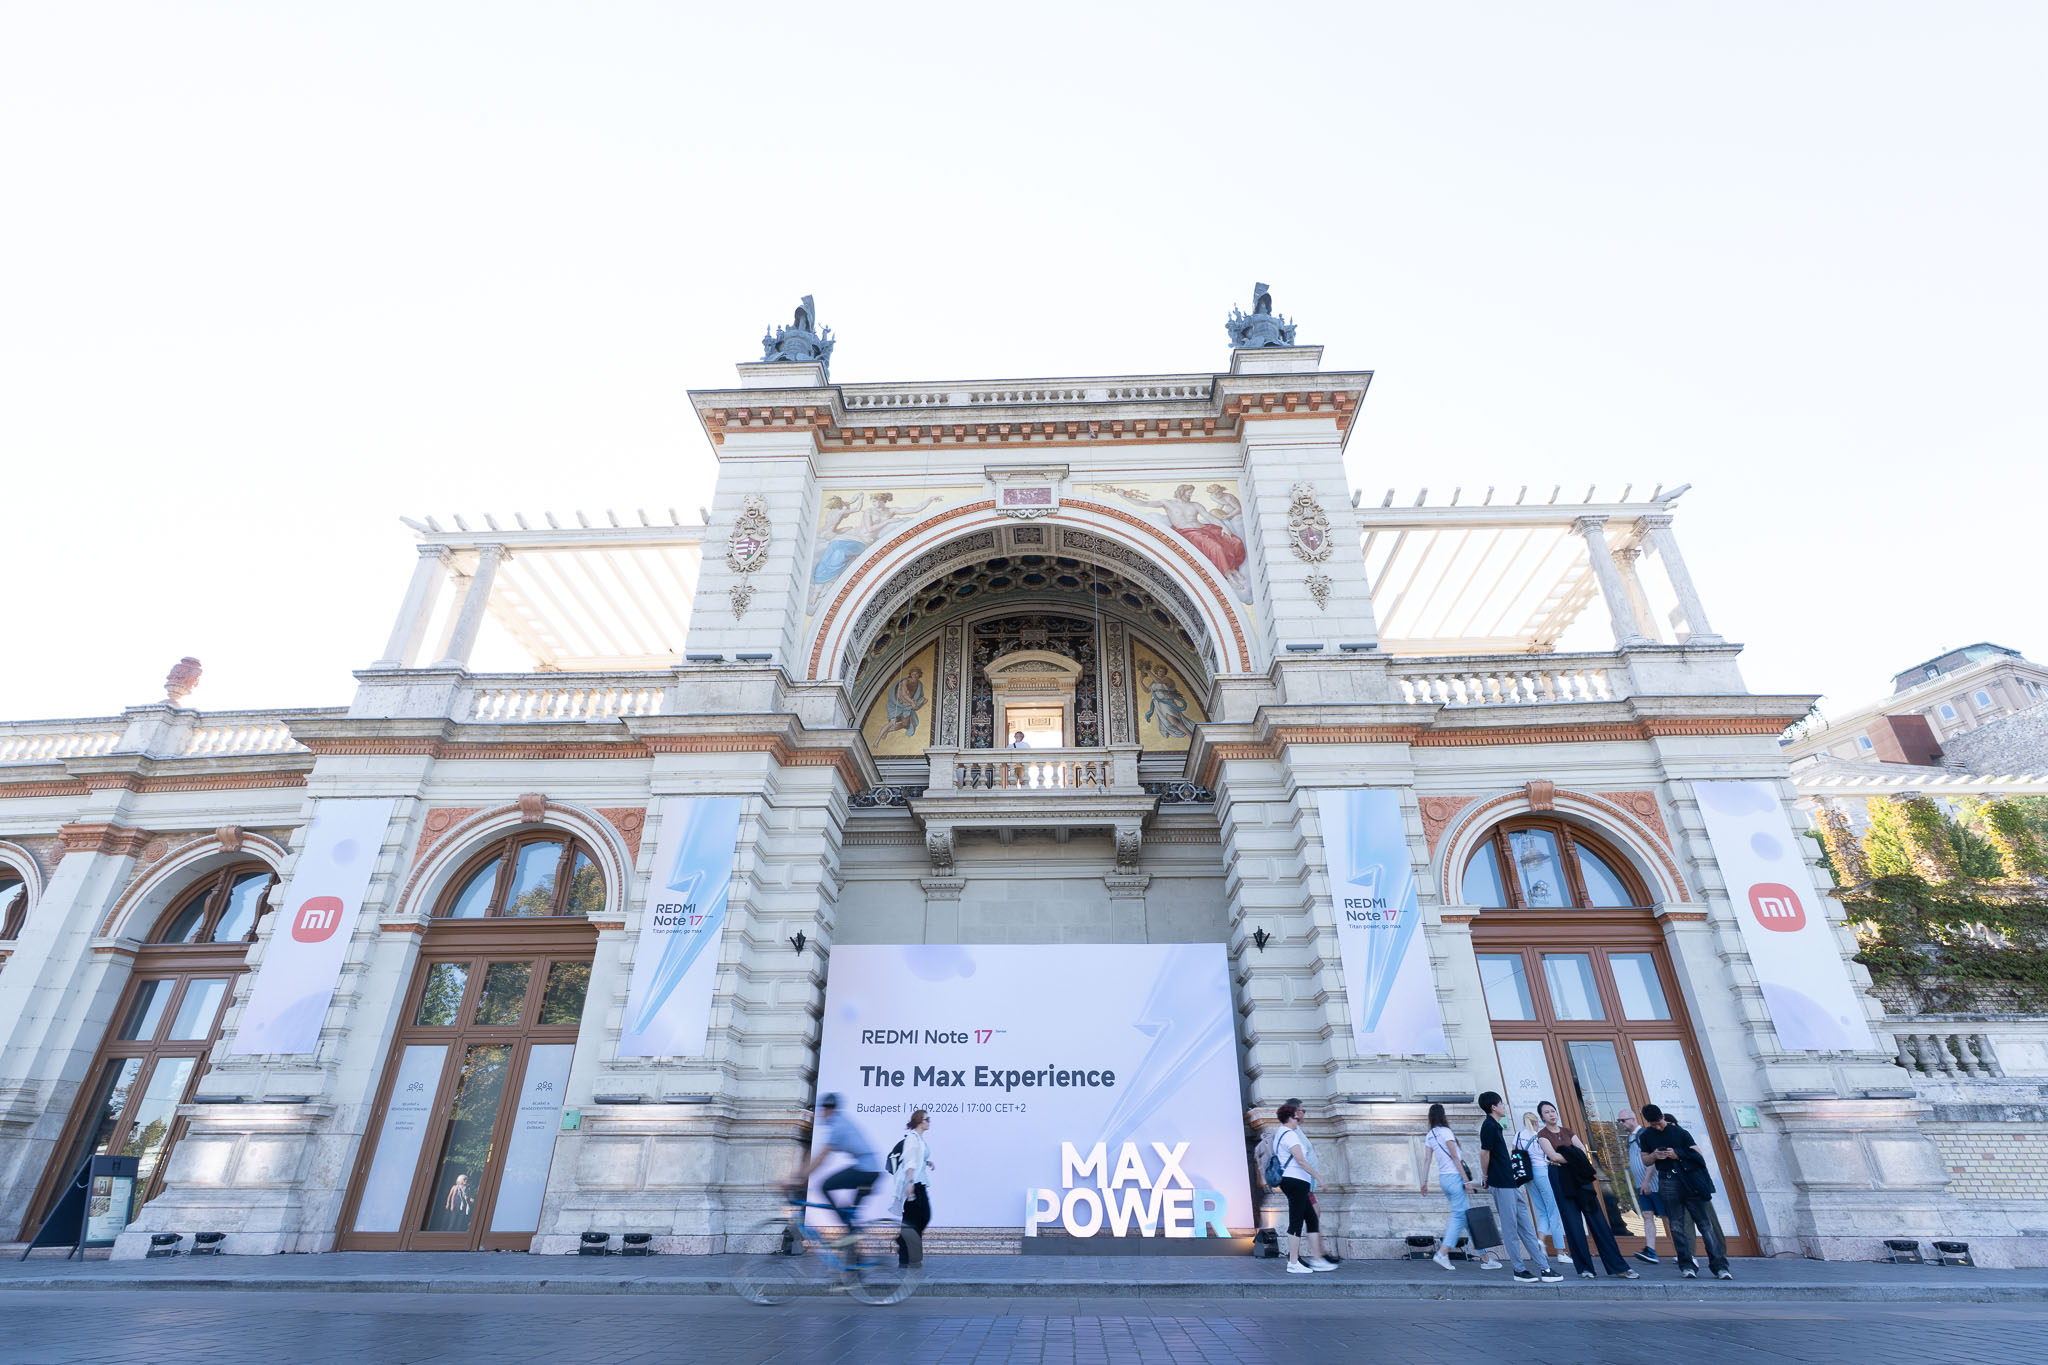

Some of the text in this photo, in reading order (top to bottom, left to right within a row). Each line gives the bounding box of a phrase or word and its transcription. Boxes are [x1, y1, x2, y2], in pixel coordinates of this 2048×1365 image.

[656, 904, 696, 914] REDMI
[1344, 898, 1386, 908] REDMI
[654, 916, 704, 926] Note 17
[1346, 910, 1397, 921] Note 17
[862, 1030, 919, 1044] REDMI
[924, 1030, 969, 1044] Note
[974, 1030, 993, 1044] 17
[860, 1064, 1116, 1092] The Max Experience
[857, 1103, 901, 1115] Budapest
[909, 1103, 959, 1112] 1609.2026
[967, 1103, 992, 1112] 17:00
[995, 1103, 1026, 1112] CET+2
[1061, 1142, 1195, 1189] MAX
[1024, 1187, 1232, 1238] POWER
